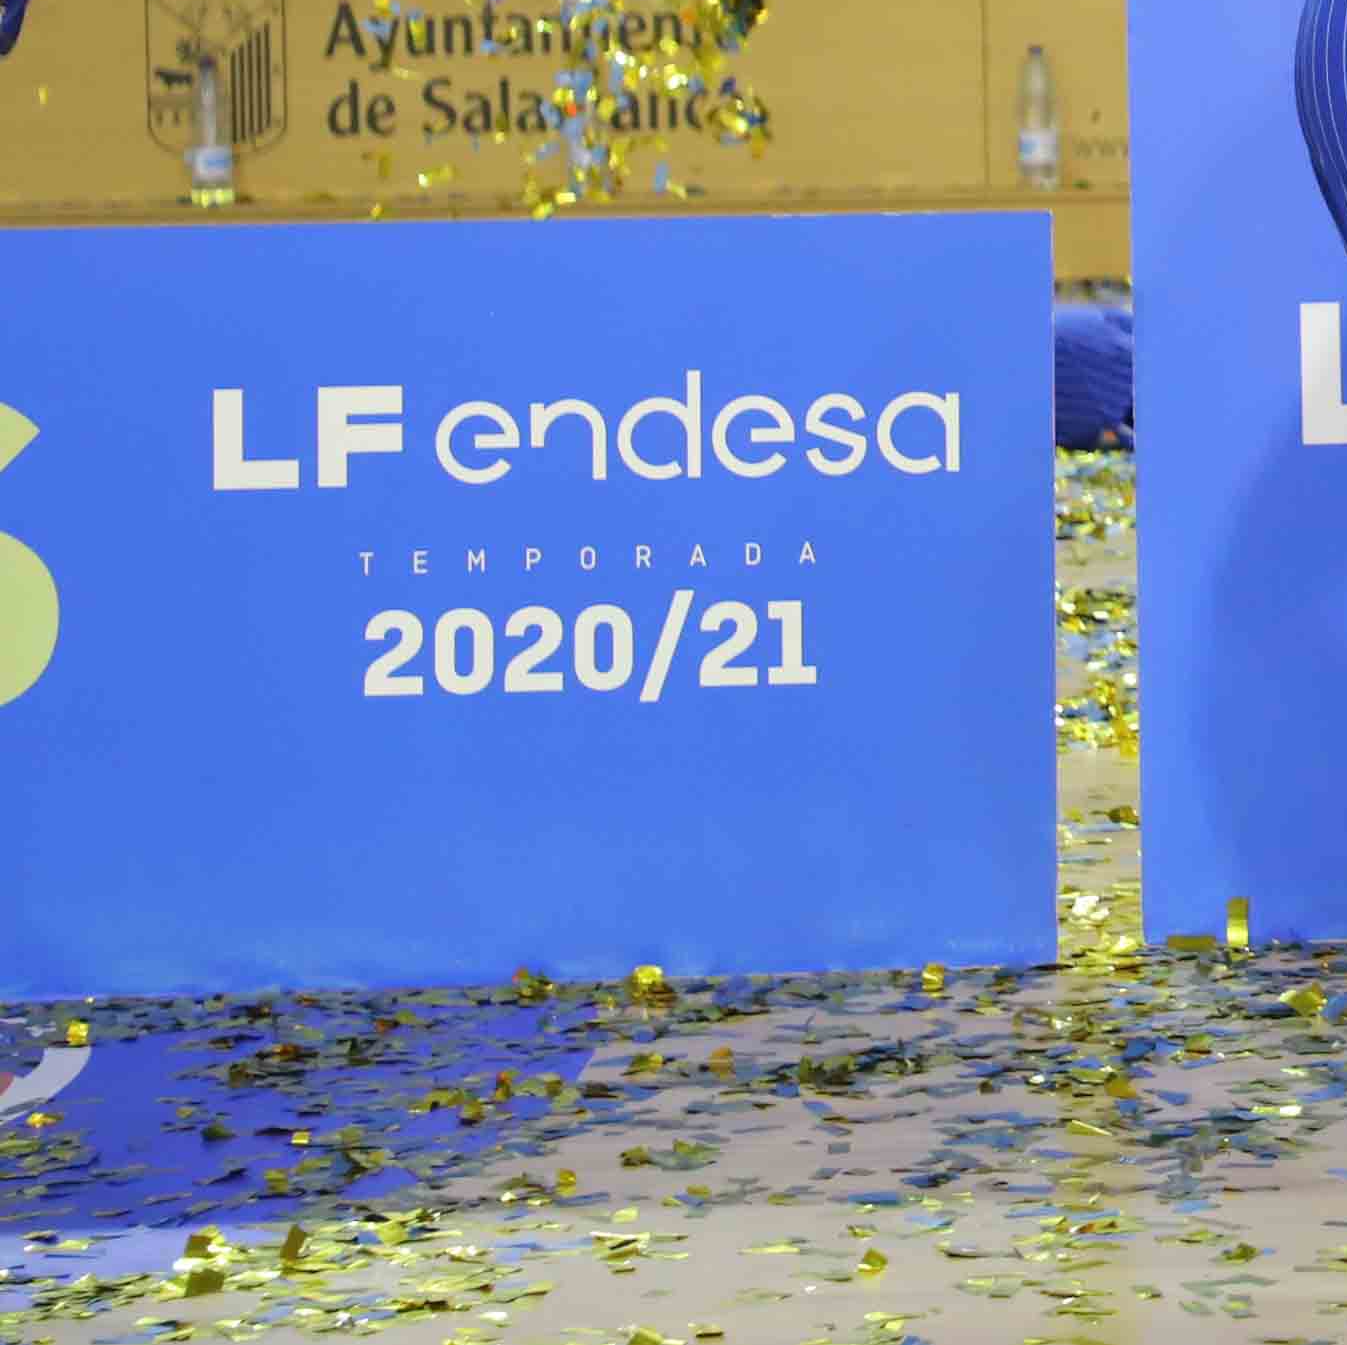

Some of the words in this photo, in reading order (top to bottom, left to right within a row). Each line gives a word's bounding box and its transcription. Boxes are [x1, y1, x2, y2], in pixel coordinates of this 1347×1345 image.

[327, 80, 396, 137] de
[212, 386, 404, 491] LF
[435, 369, 961, 485] endesa
[358, 541, 817, 577] TEMPORADA
[362, 589, 818, 704] 2020/21
